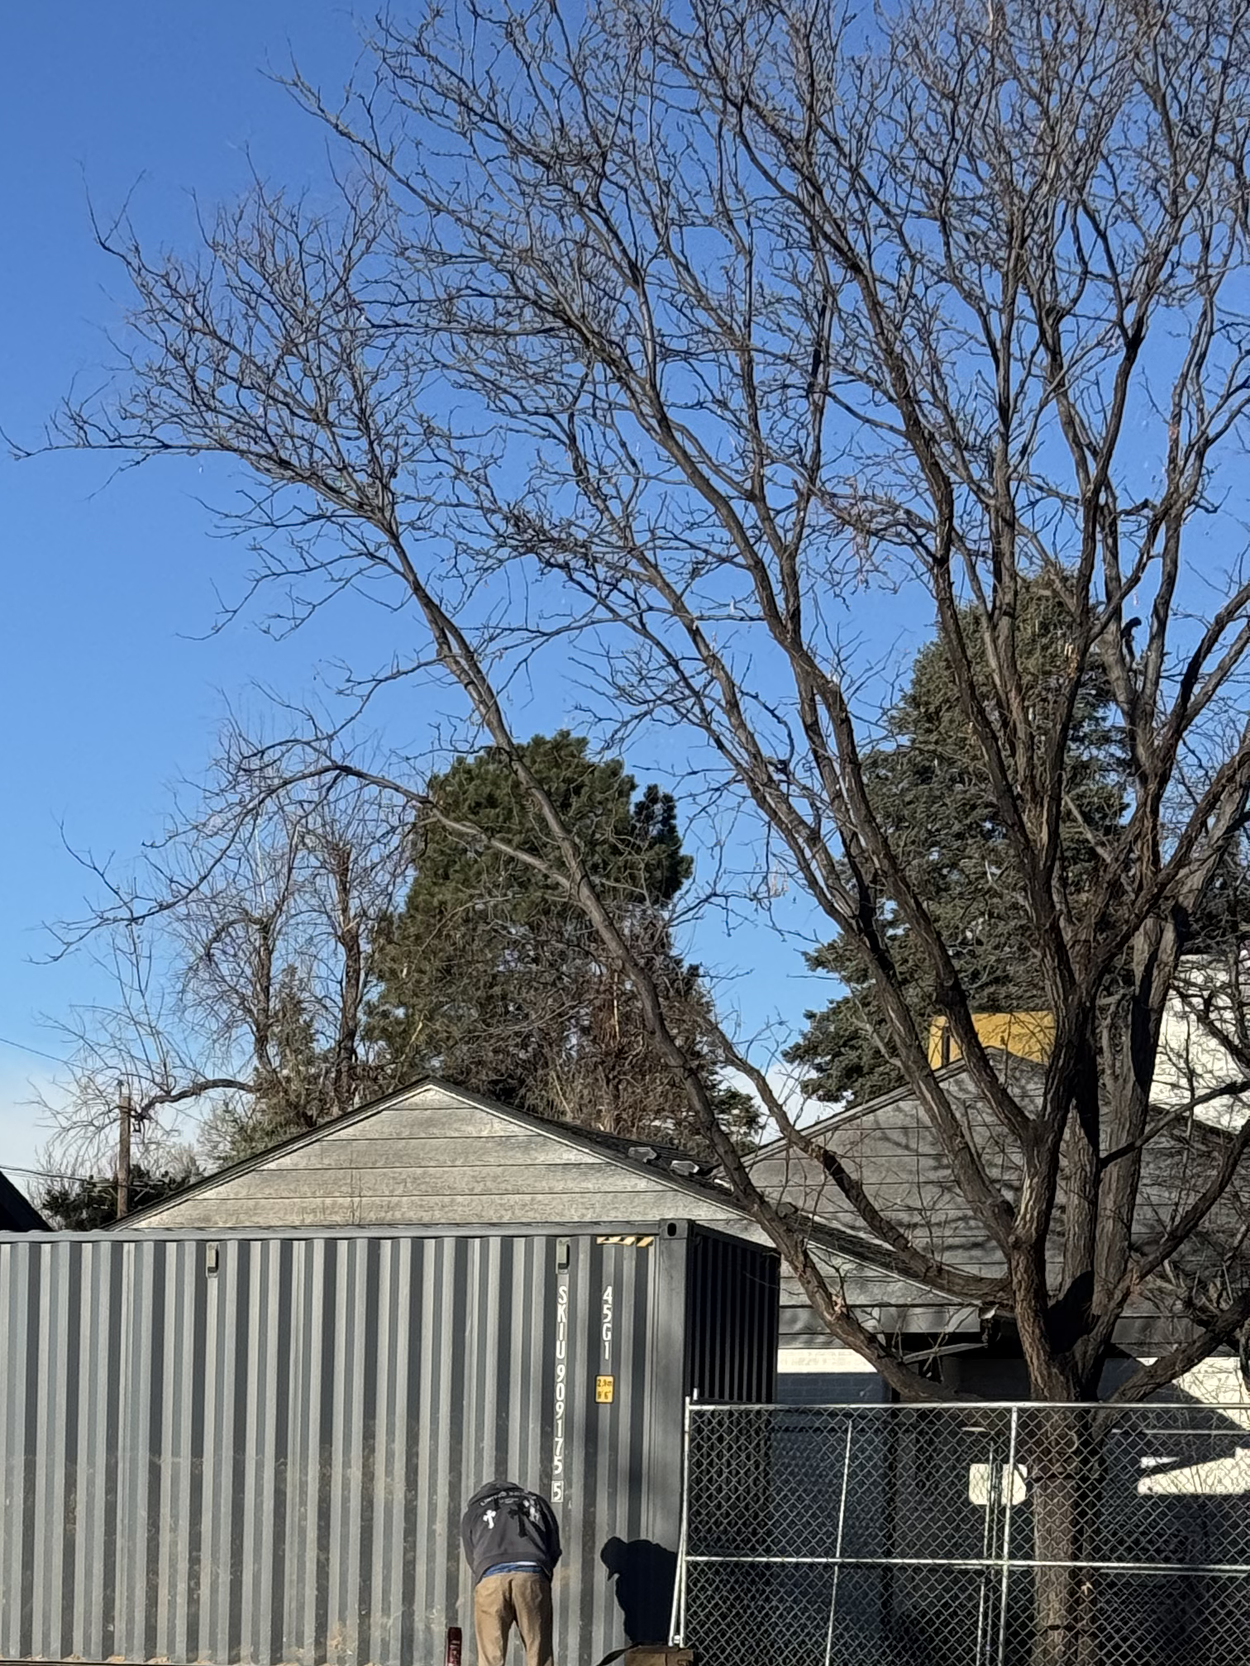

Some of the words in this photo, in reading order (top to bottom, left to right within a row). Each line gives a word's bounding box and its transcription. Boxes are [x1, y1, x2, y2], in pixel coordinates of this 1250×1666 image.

[556, 1285, 568, 1359] SKIU
[602, 1285, 613, 1360] 45G1
[552, 1364, 566, 1474] 909175
